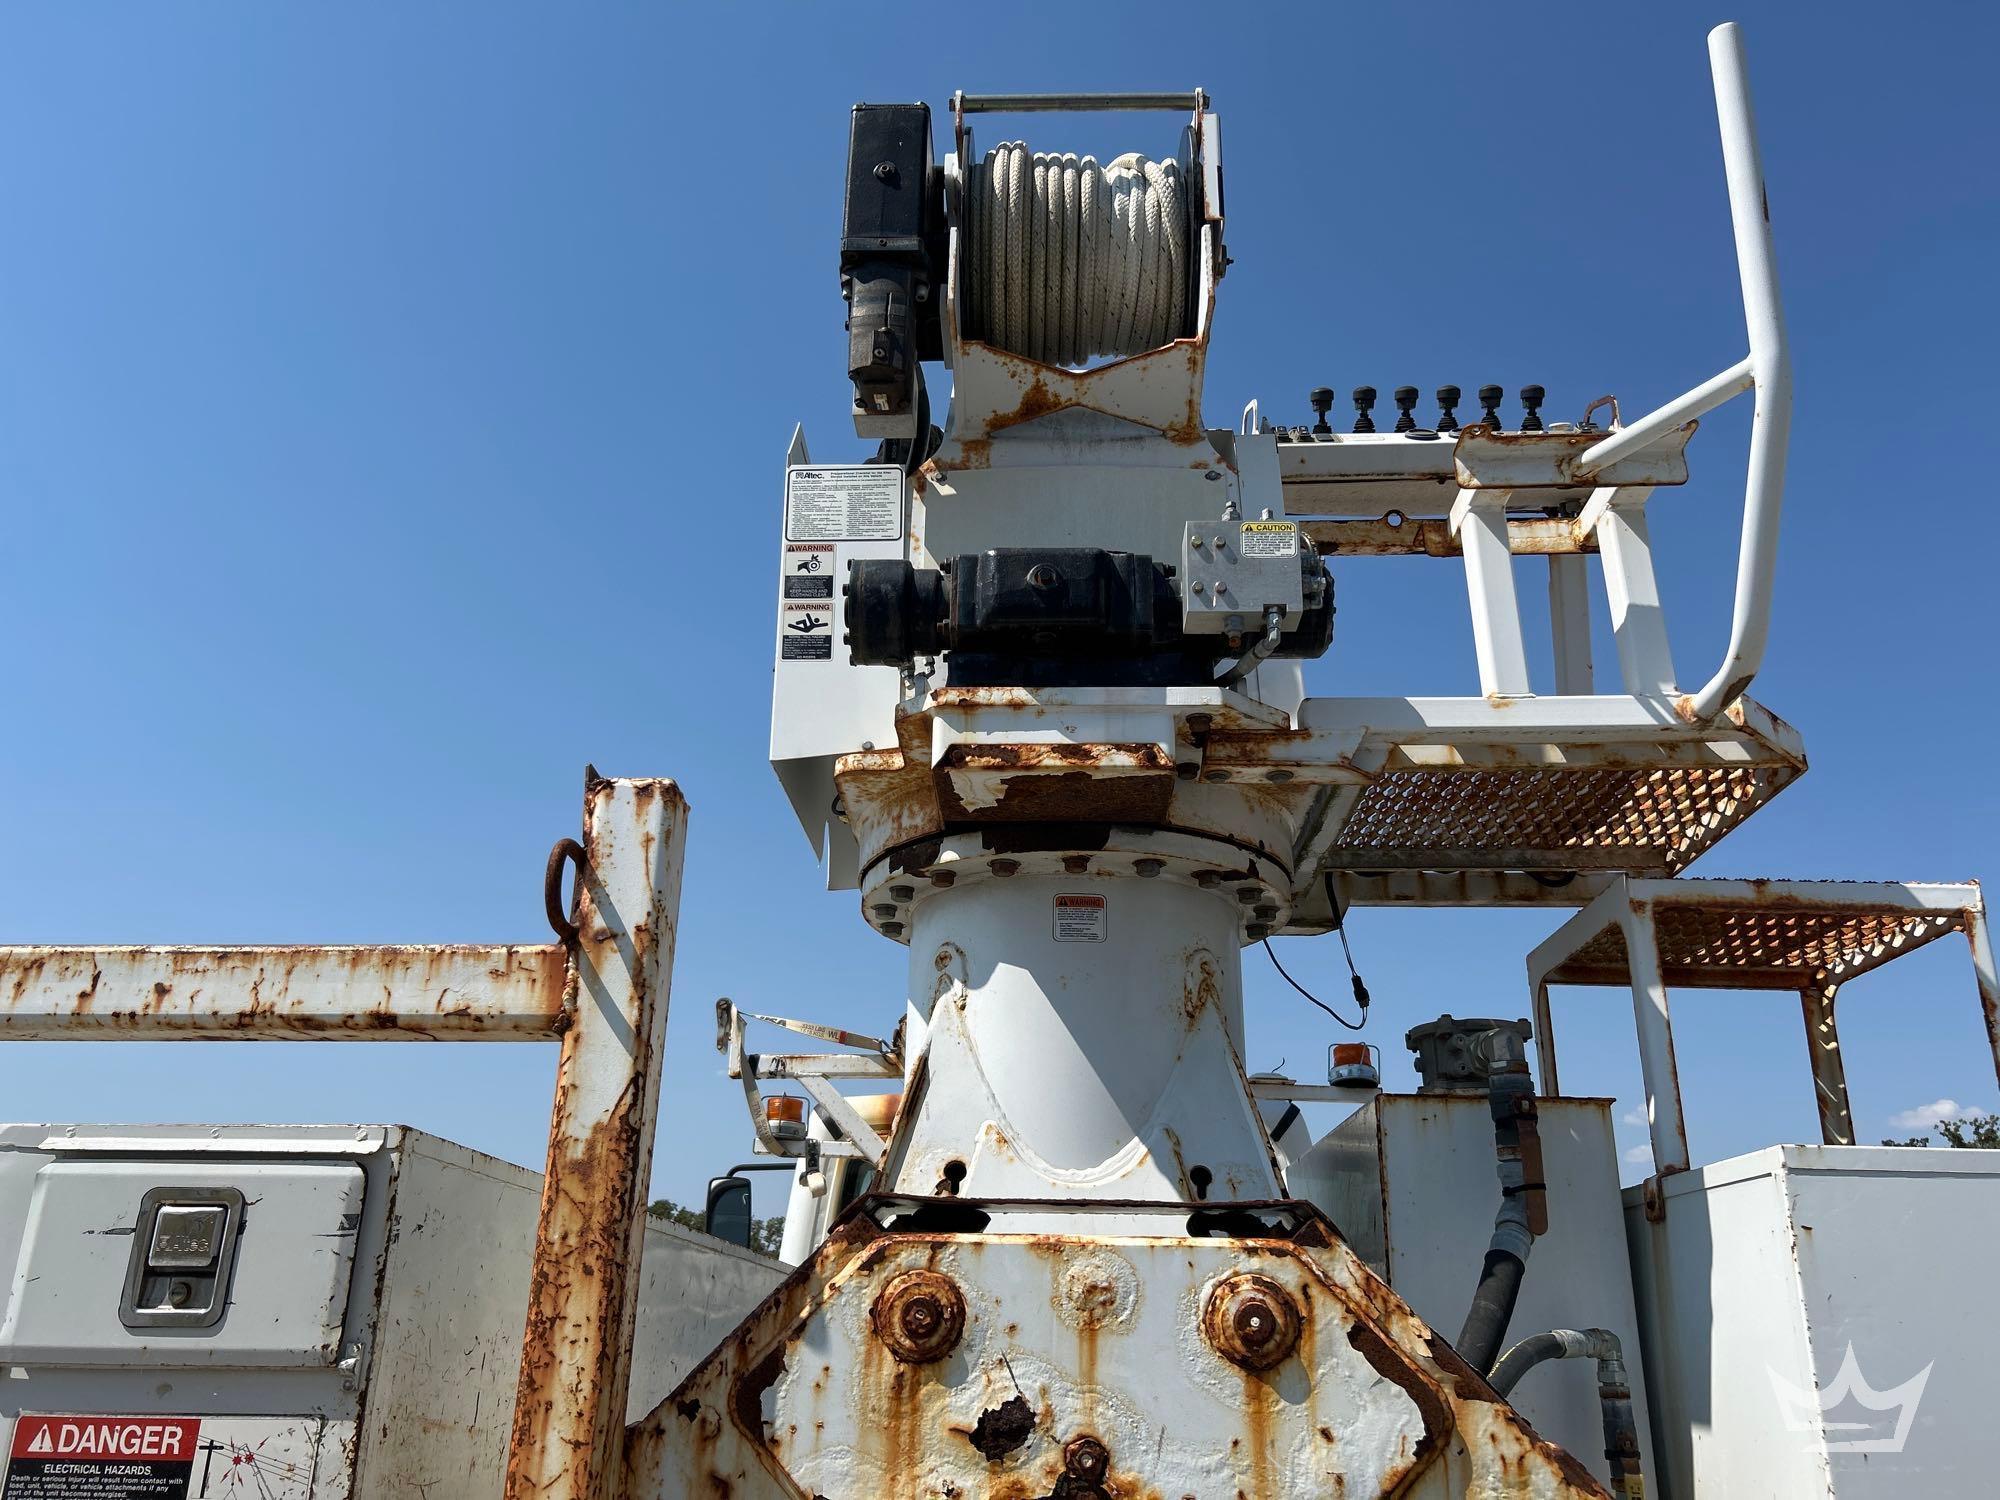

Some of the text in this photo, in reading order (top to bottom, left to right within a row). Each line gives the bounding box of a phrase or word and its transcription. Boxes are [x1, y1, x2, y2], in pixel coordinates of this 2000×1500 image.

[1069, 898, 1101, 907] WARNING
[58, 1424, 183, 1455] DANGER
[44, 1464, 101, 1475] ELECTRICAL
